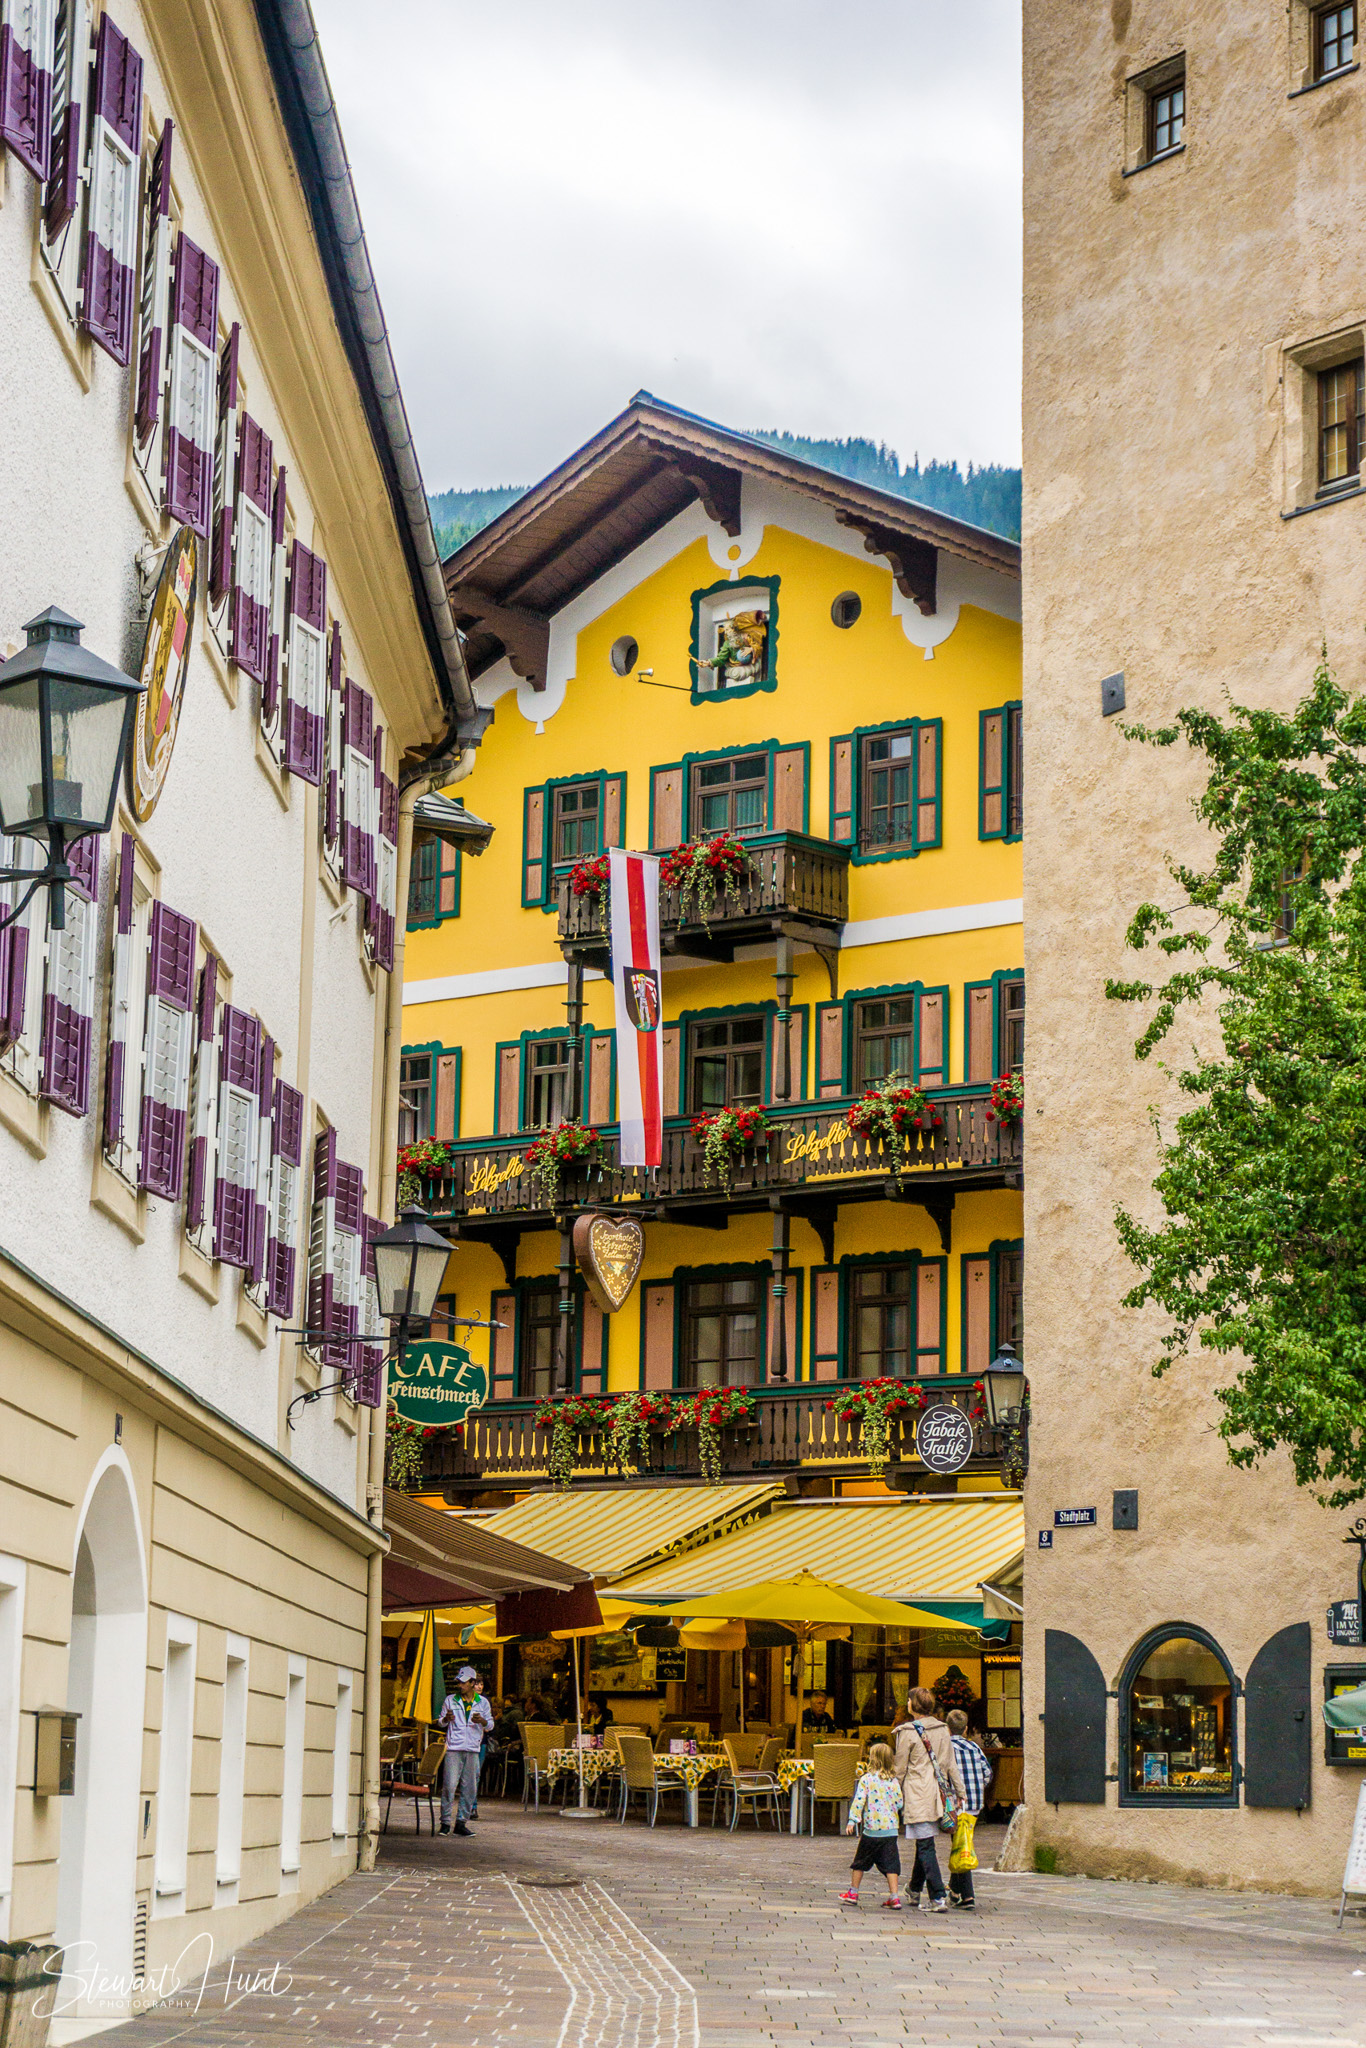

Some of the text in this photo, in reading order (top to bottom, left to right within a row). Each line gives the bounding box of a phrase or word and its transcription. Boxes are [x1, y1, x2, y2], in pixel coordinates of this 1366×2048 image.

[395, 1353, 477, 1387] CAFE
[388, 1380, 480, 1405] Feinschmeck
[922, 1417, 968, 1439] Tabak
[922, 1438, 967, 1459] Trafik
[1059, 1510, 1090, 1523] Stadtplatz
[1041, 1531, 1049, 1542] 8
